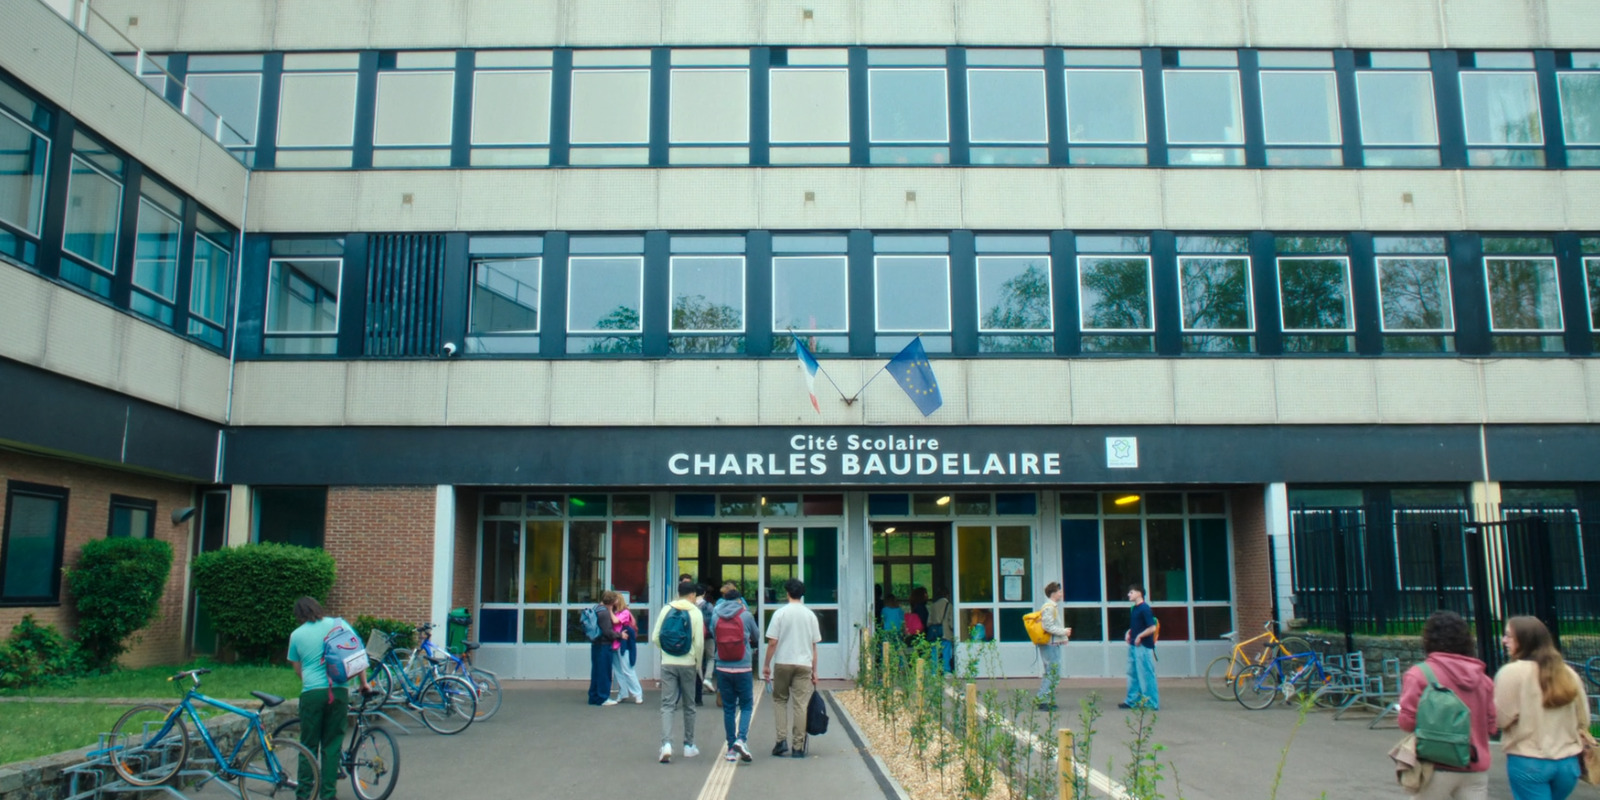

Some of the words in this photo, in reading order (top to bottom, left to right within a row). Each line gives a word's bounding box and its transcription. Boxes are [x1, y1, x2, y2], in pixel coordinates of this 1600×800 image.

[790, 434, 838, 451] Cité
[847, 434, 939, 451] Scolaire
[668, 453, 827, 475] CHARLES
[841, 453, 1061, 475] BAUDELAIRE
